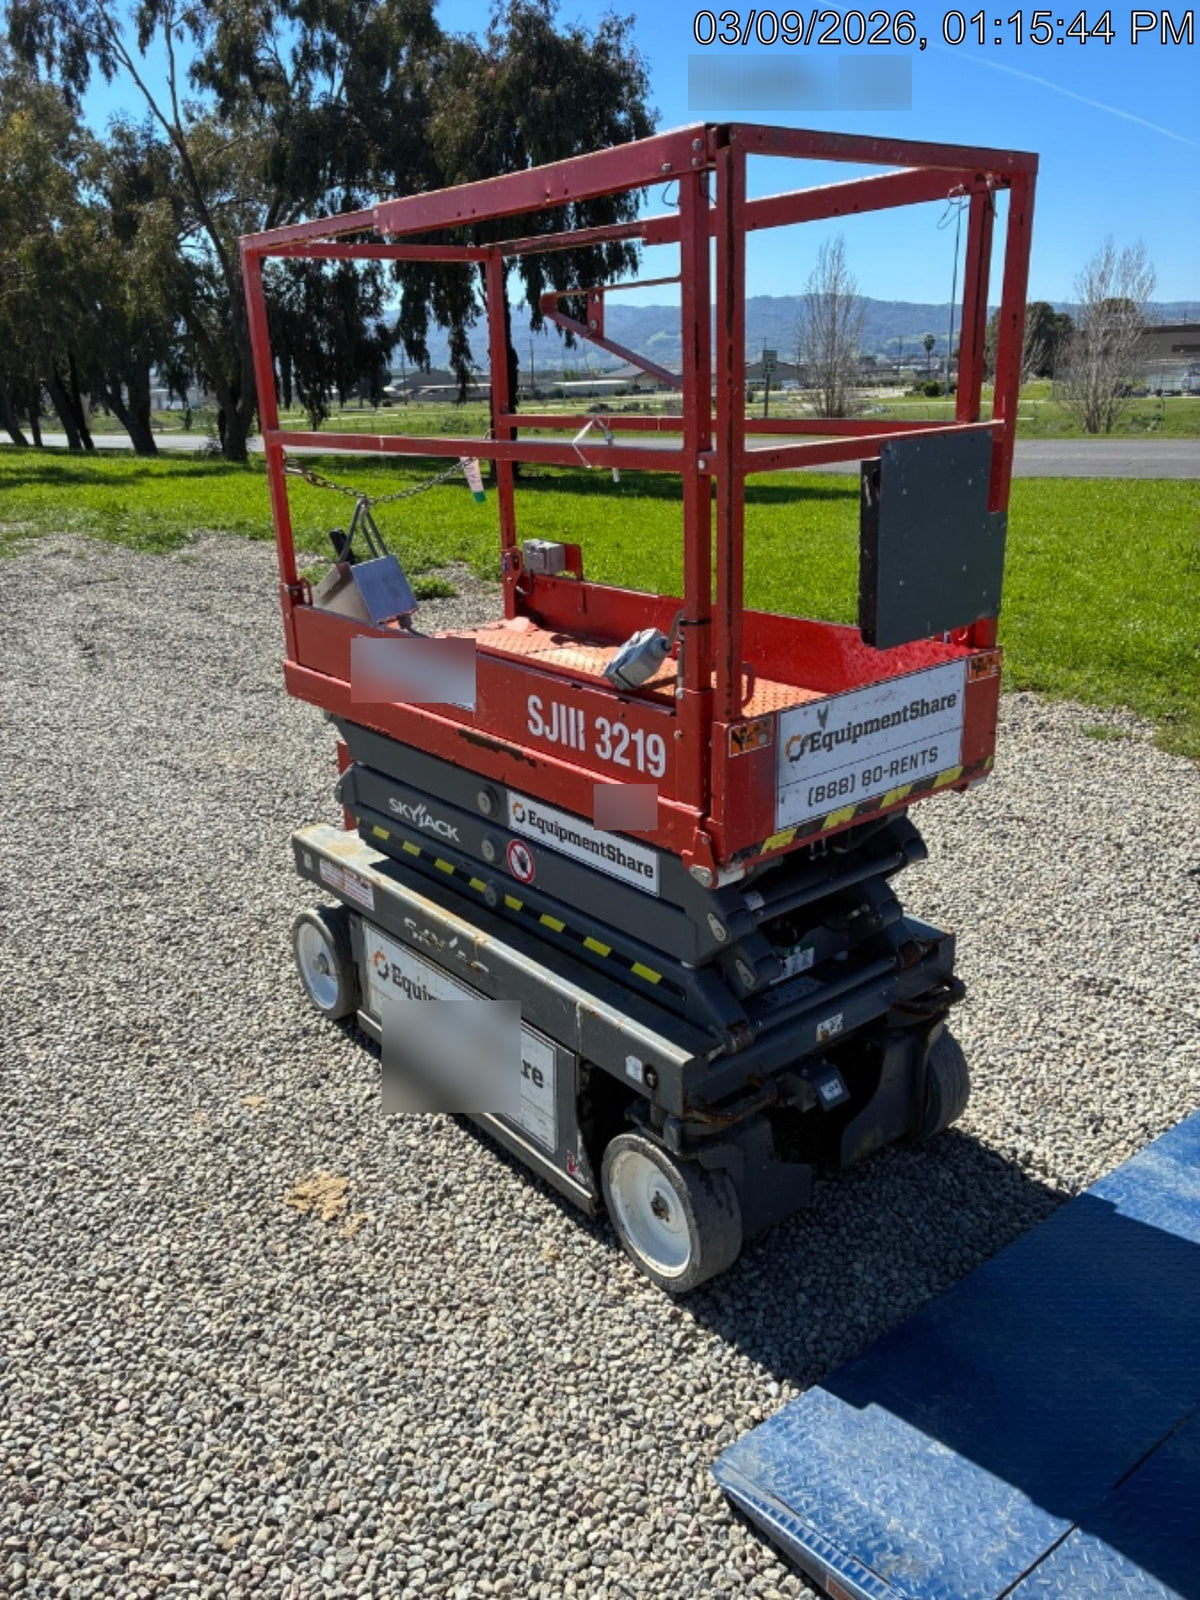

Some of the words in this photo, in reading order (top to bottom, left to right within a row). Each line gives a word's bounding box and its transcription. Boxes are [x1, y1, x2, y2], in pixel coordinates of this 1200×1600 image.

[595, 716, 666, 778] 3219
[808, 693, 957, 752] EquipmentShare
[807, 774, 857, 808] (888)
[861, 746, 939, 788] 80-RENTS
[389, 797, 461, 843] SKYJACK
[527, 809, 654, 879] EquipmentShare
